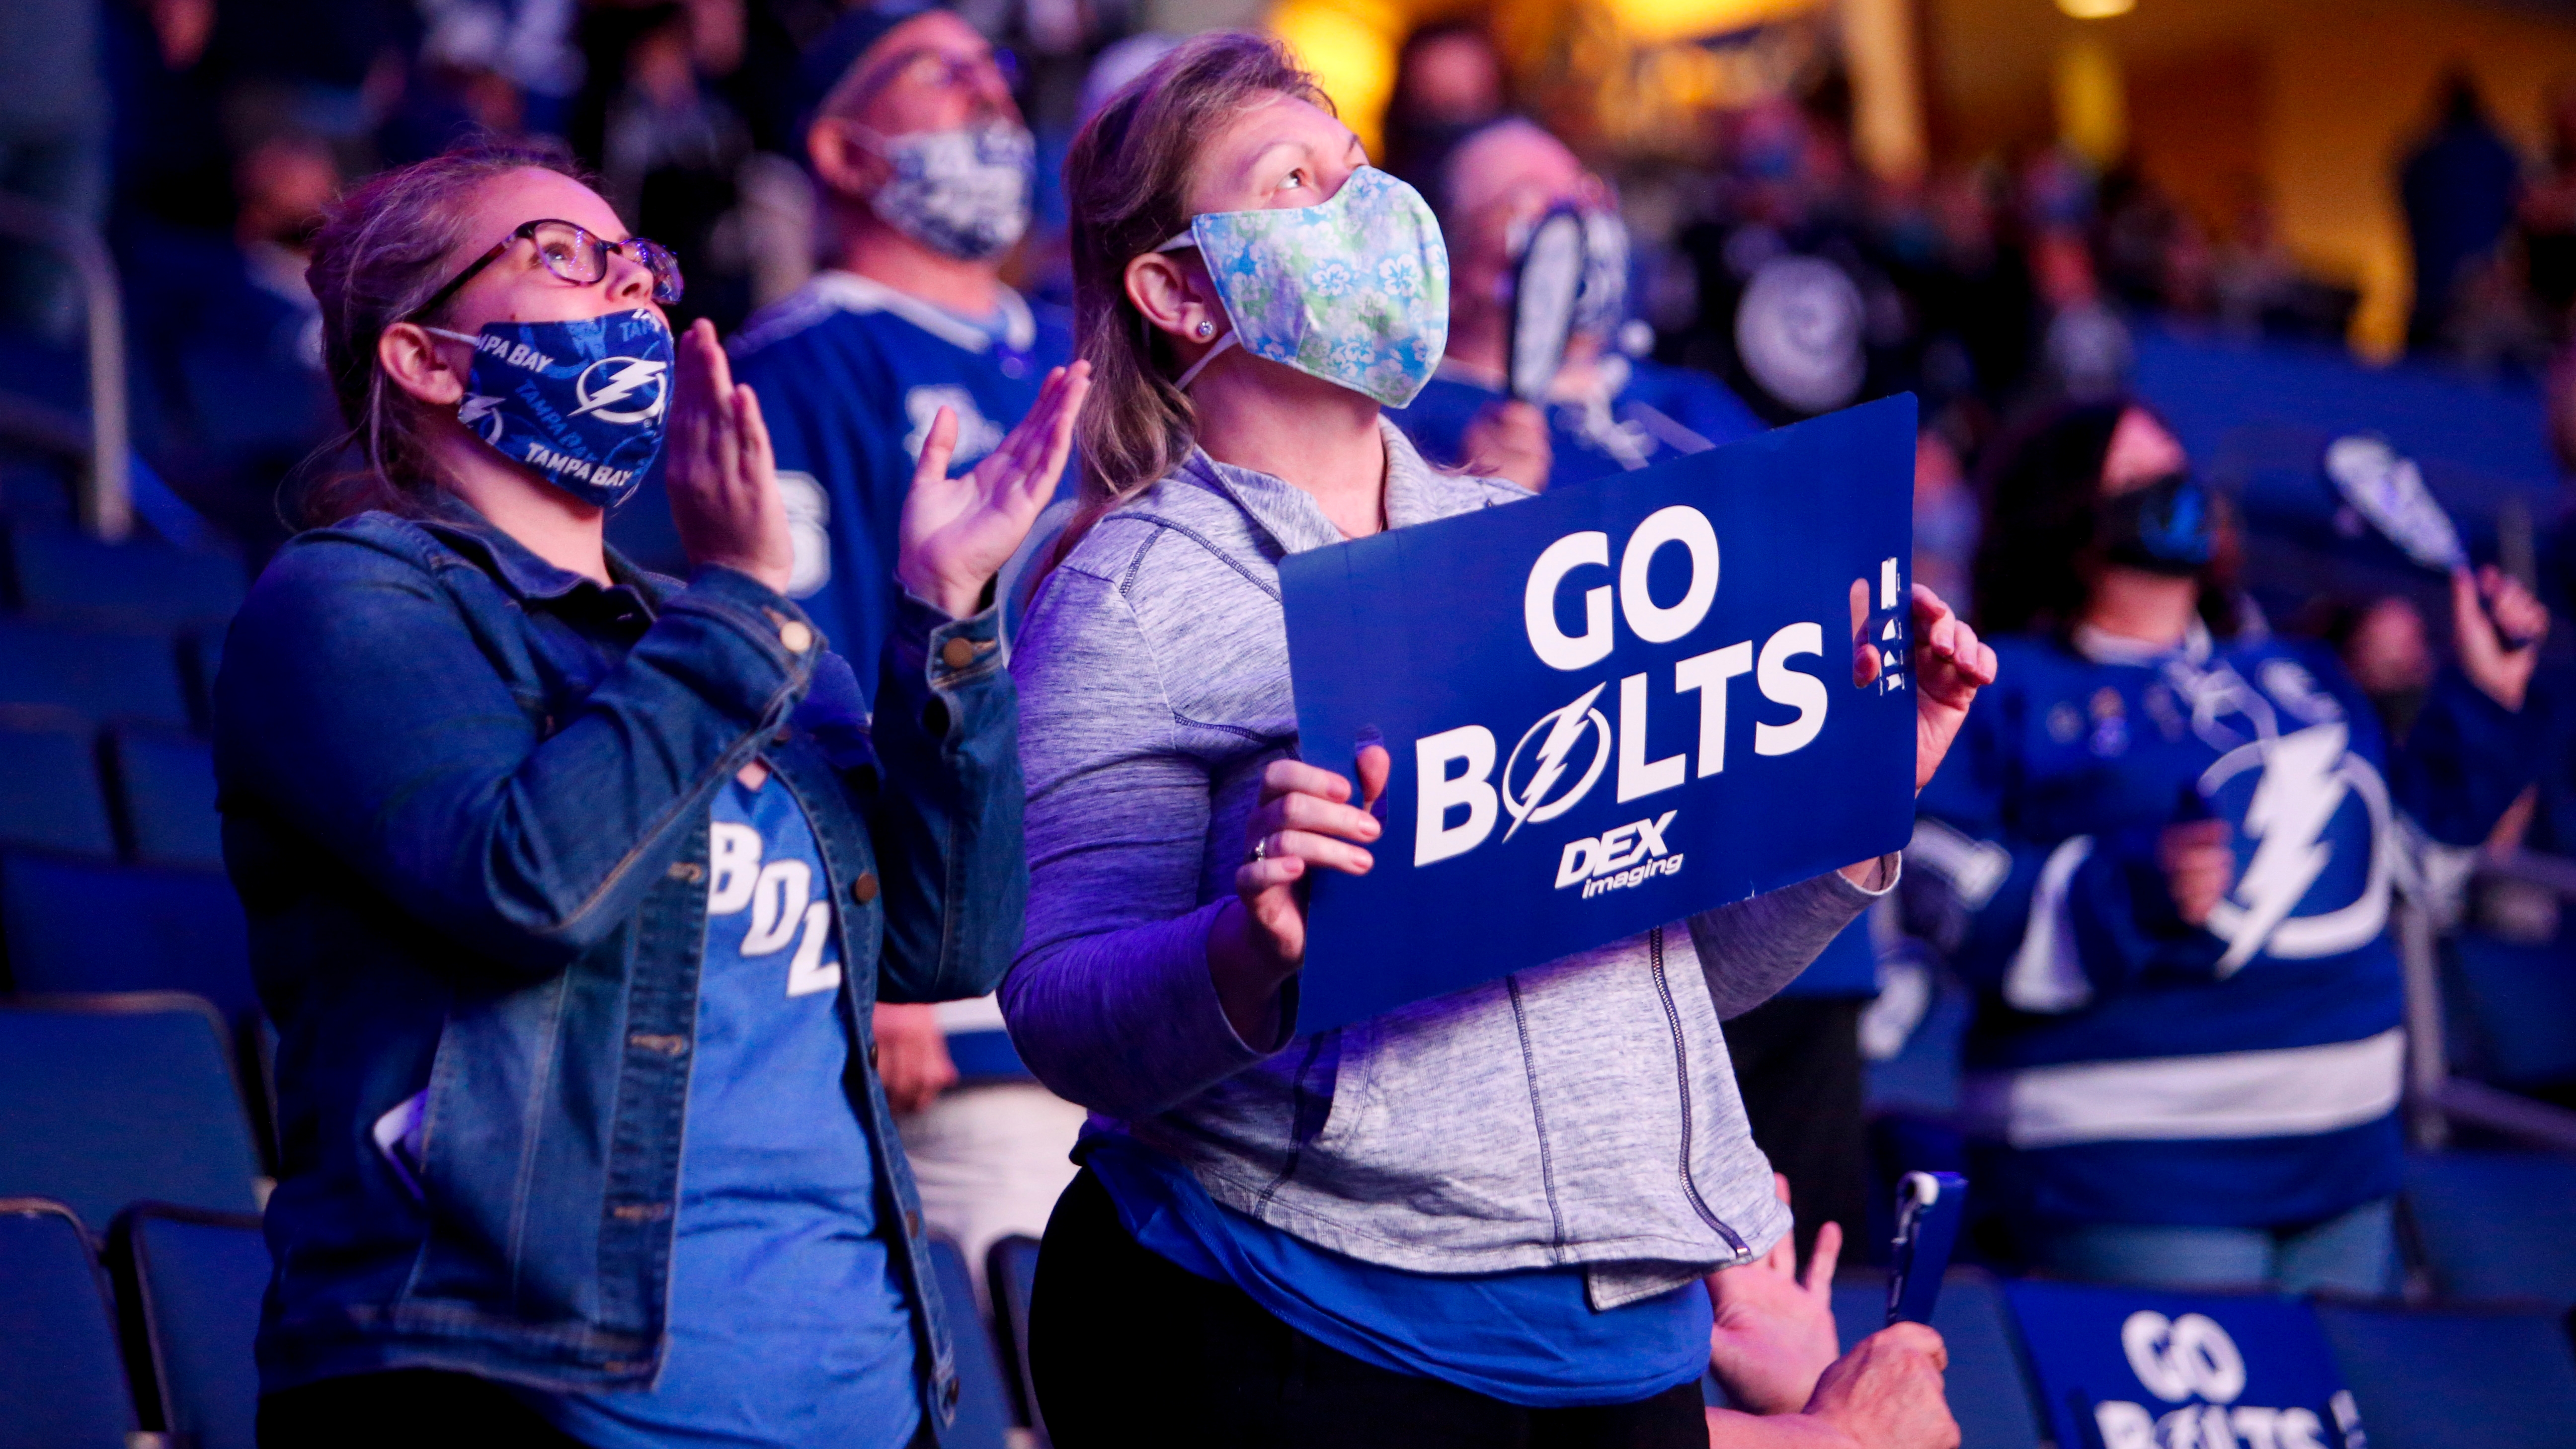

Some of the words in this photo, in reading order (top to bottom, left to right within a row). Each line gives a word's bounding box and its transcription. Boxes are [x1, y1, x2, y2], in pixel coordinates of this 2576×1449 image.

[506, 343, 555, 373] BAY
[525, 441, 591, 480] TAMPA
[589, 465, 634, 486] BAY
[1524, 504, 1720, 671] GO
[1554, 809, 1678, 889] DEX
[1582, 853, 1684, 899] imaging
